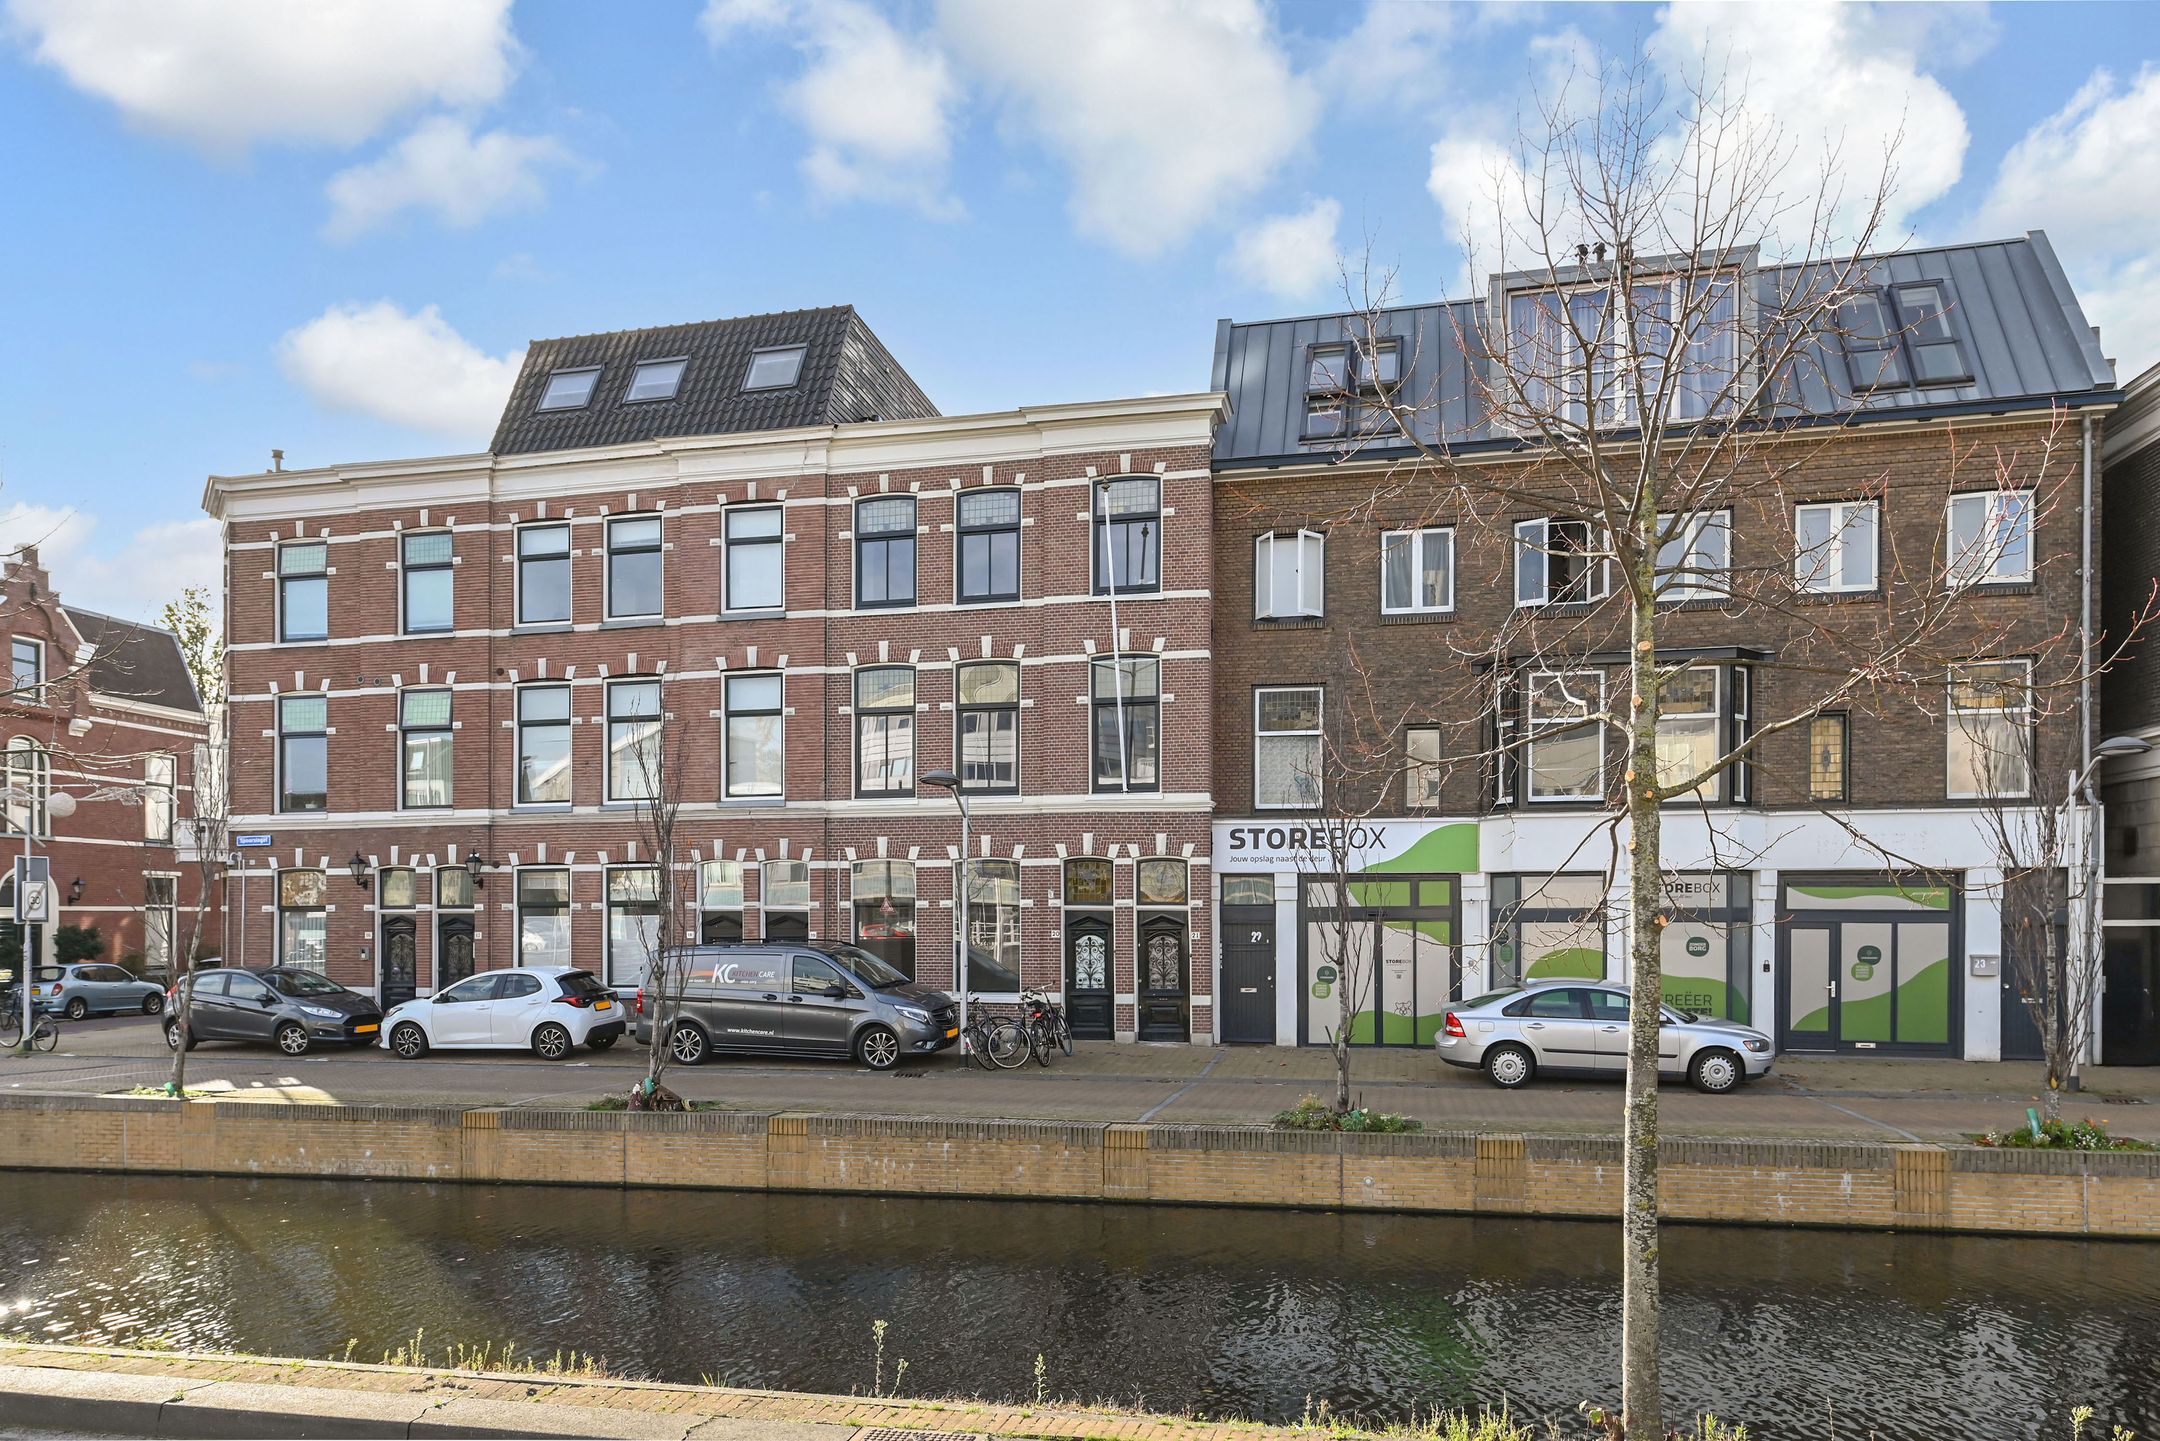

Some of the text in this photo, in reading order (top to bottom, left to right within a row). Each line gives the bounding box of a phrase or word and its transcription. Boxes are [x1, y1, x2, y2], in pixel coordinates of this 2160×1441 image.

[1229, 827, 1387, 850] STOREBOX
[1230, 855, 1248, 863] Jouw
[1250, 855, 1274, 864] opslag
[1658, 882, 1720, 894] TOREBOX
[30, 896, 41, 905] 30
[1974, 959, 1986, 968] 23
[711, 963, 739, 984] KC
[1660, 991, 1713, 1006] REËER
[727, 1027, 775, 1036] www.kitchencare.nl
